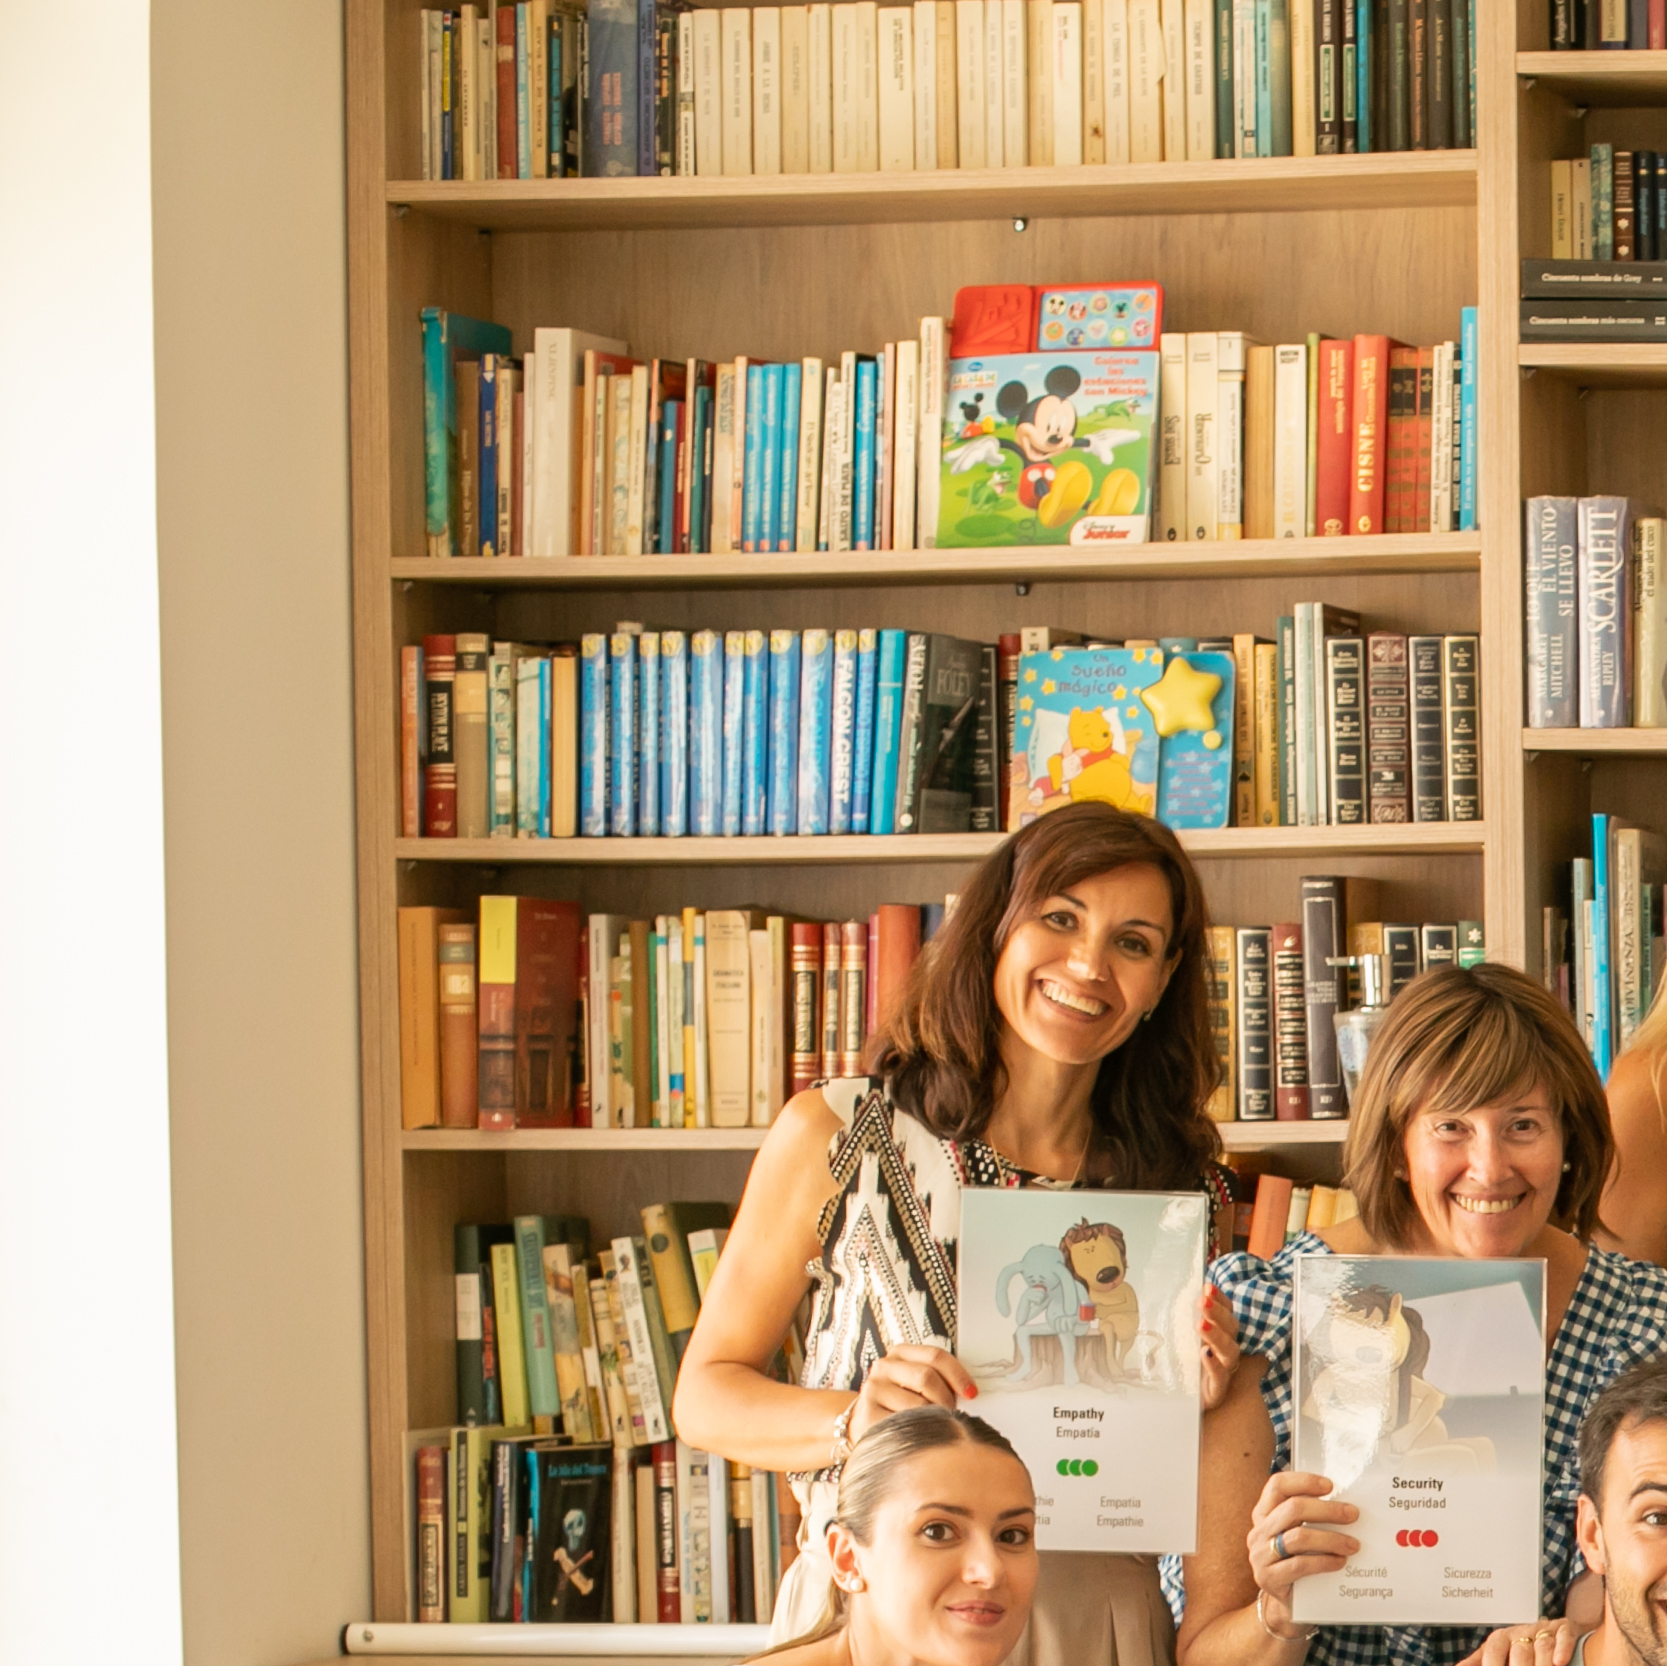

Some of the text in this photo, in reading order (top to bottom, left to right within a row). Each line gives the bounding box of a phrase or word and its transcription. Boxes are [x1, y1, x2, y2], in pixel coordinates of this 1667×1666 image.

[1107, 386, 1148, 397] Mickey
[1356, 423, 1377, 492] CISNE
[1541, 505, 1558, 594] EL VIENTO
[1586, 506, 1625, 634] SCARLETT
[1558, 544, 1575, 617] SE LLEVO
[1550, 633, 1564, 698] MITCHELL
[1602, 651, 1615, 686] RIPLEY
[1058, 678, 1117, 697] mágico
[833, 659, 854, 803] FALCON CREST
[1052, 1407, 1105, 1422] Empathy
[1056, 1426, 1101, 1440] Empatía
[1392, 1476, 1444, 1492] Security
[1099, 1496, 1142, 1510] Empatia
[1388, 1496, 1447, 1511] Seguridad
[1096, 1515, 1144, 1529] Empathie
[1345, 1565, 1388, 1578] Sécurité
[1443, 1566, 1492, 1579] Sicurezza
[1339, 1585, 1394, 1600] Segurança
[1441, 1586, 1494, 1599] Sicherheit
